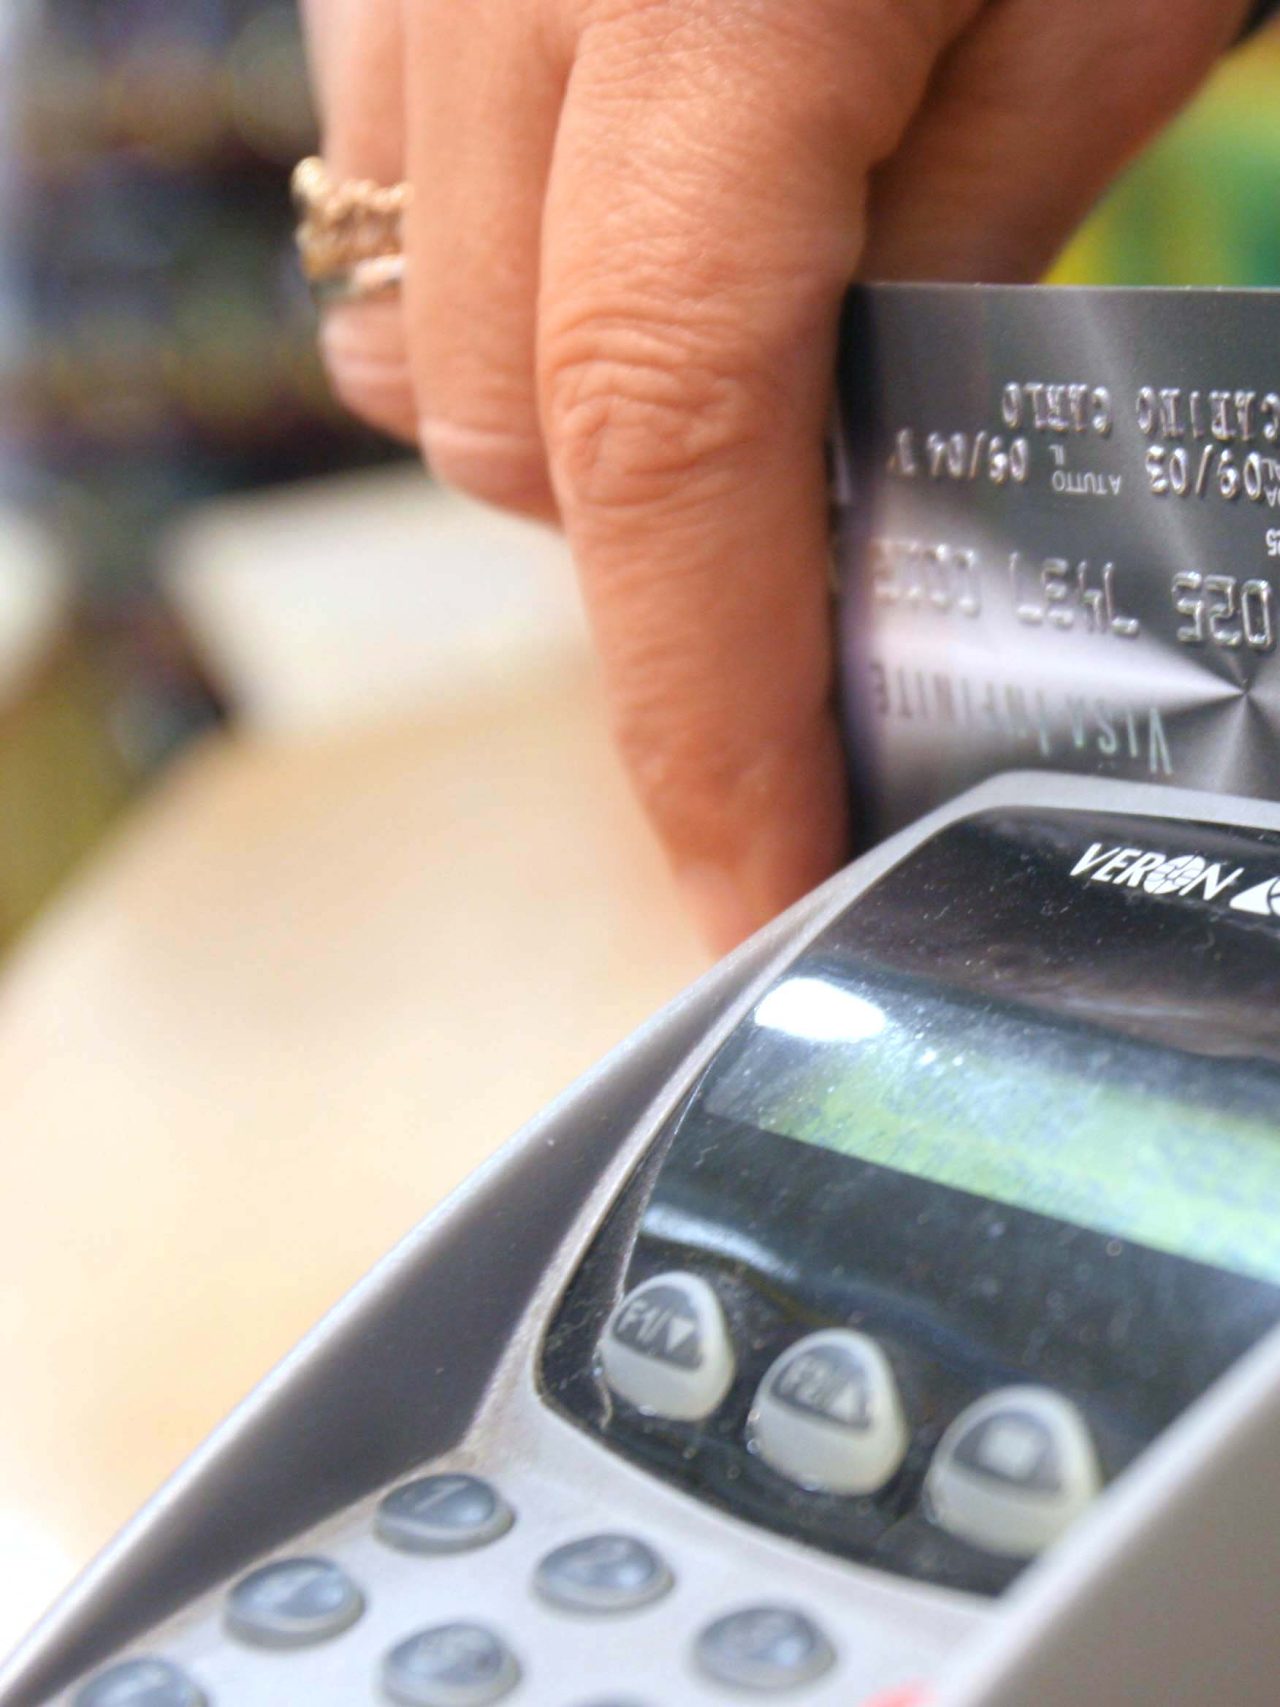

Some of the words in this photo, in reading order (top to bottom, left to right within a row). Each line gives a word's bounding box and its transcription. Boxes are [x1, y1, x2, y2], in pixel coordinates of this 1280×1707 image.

[1002, 382, 1112, 433] CARLO
[1051, 469, 1108, 495] TUTTO
[1145, 444, 1262, 500] 09/03
[1069, 842, 1246, 901] VERON
